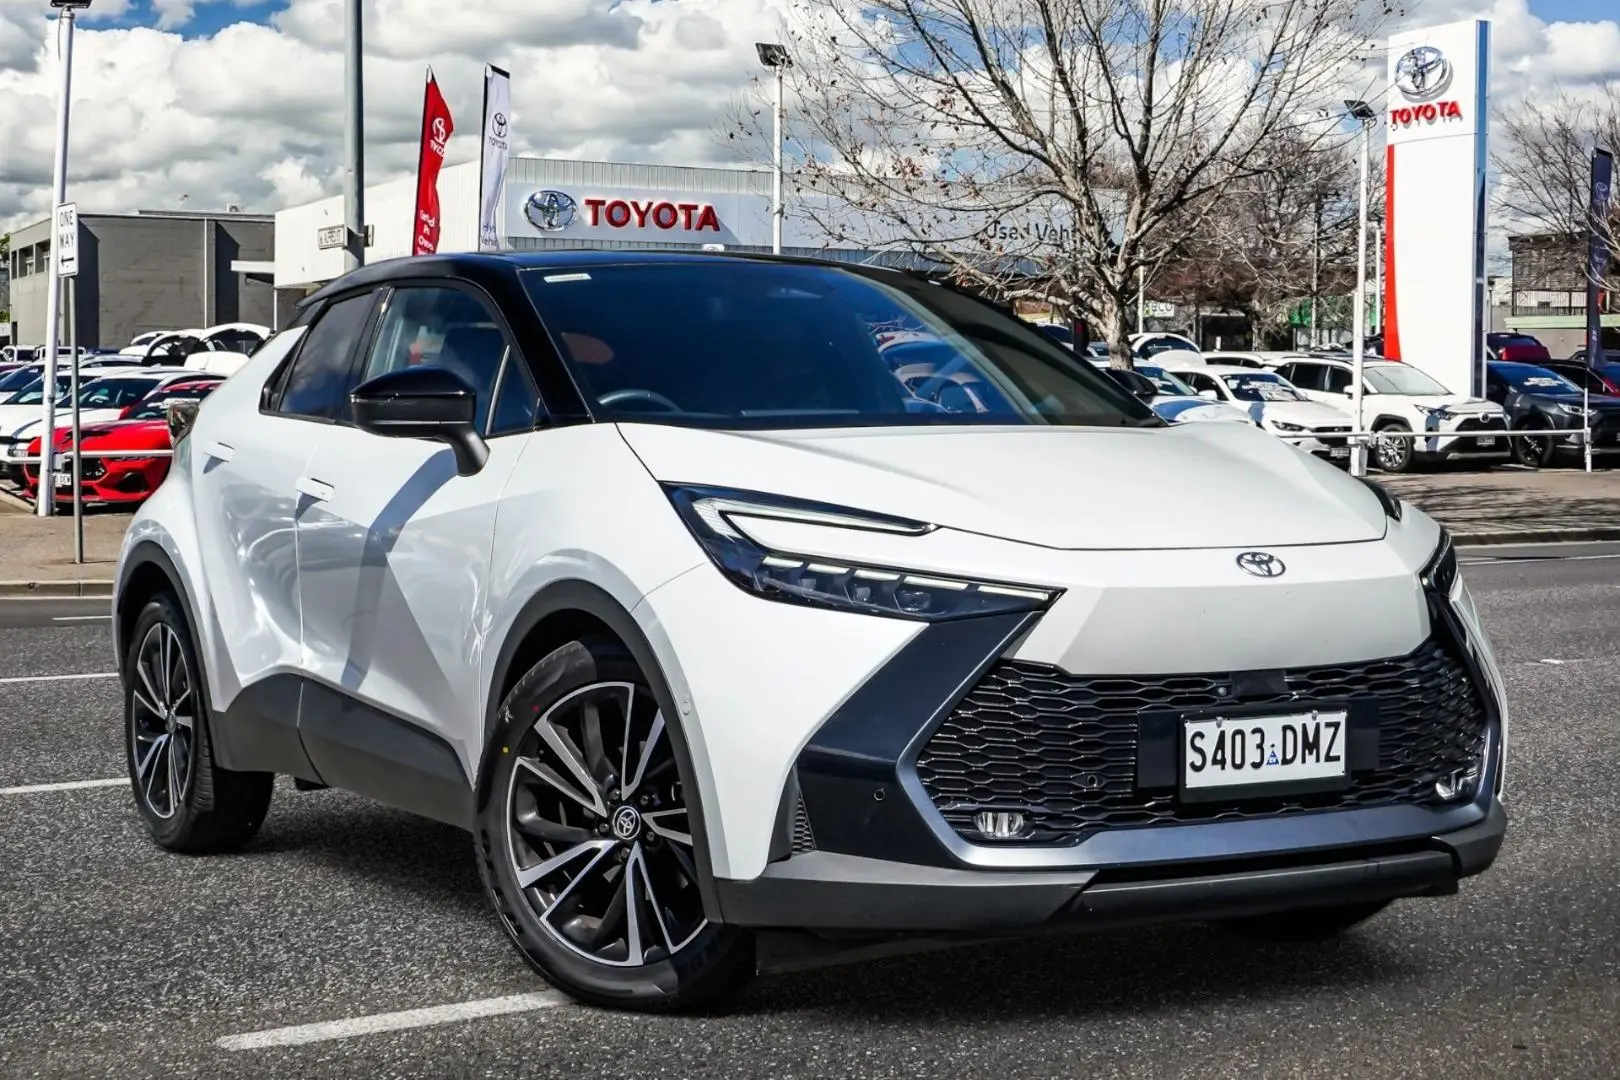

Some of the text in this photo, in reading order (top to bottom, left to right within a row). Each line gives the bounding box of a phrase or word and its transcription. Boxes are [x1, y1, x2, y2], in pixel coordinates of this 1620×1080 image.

[1390, 101, 1462, 125] TOYOTA
[60, 209, 74, 228] ONE
[585, 199, 720, 231] TOYOTA
[59, 231, 75, 249] WAY
